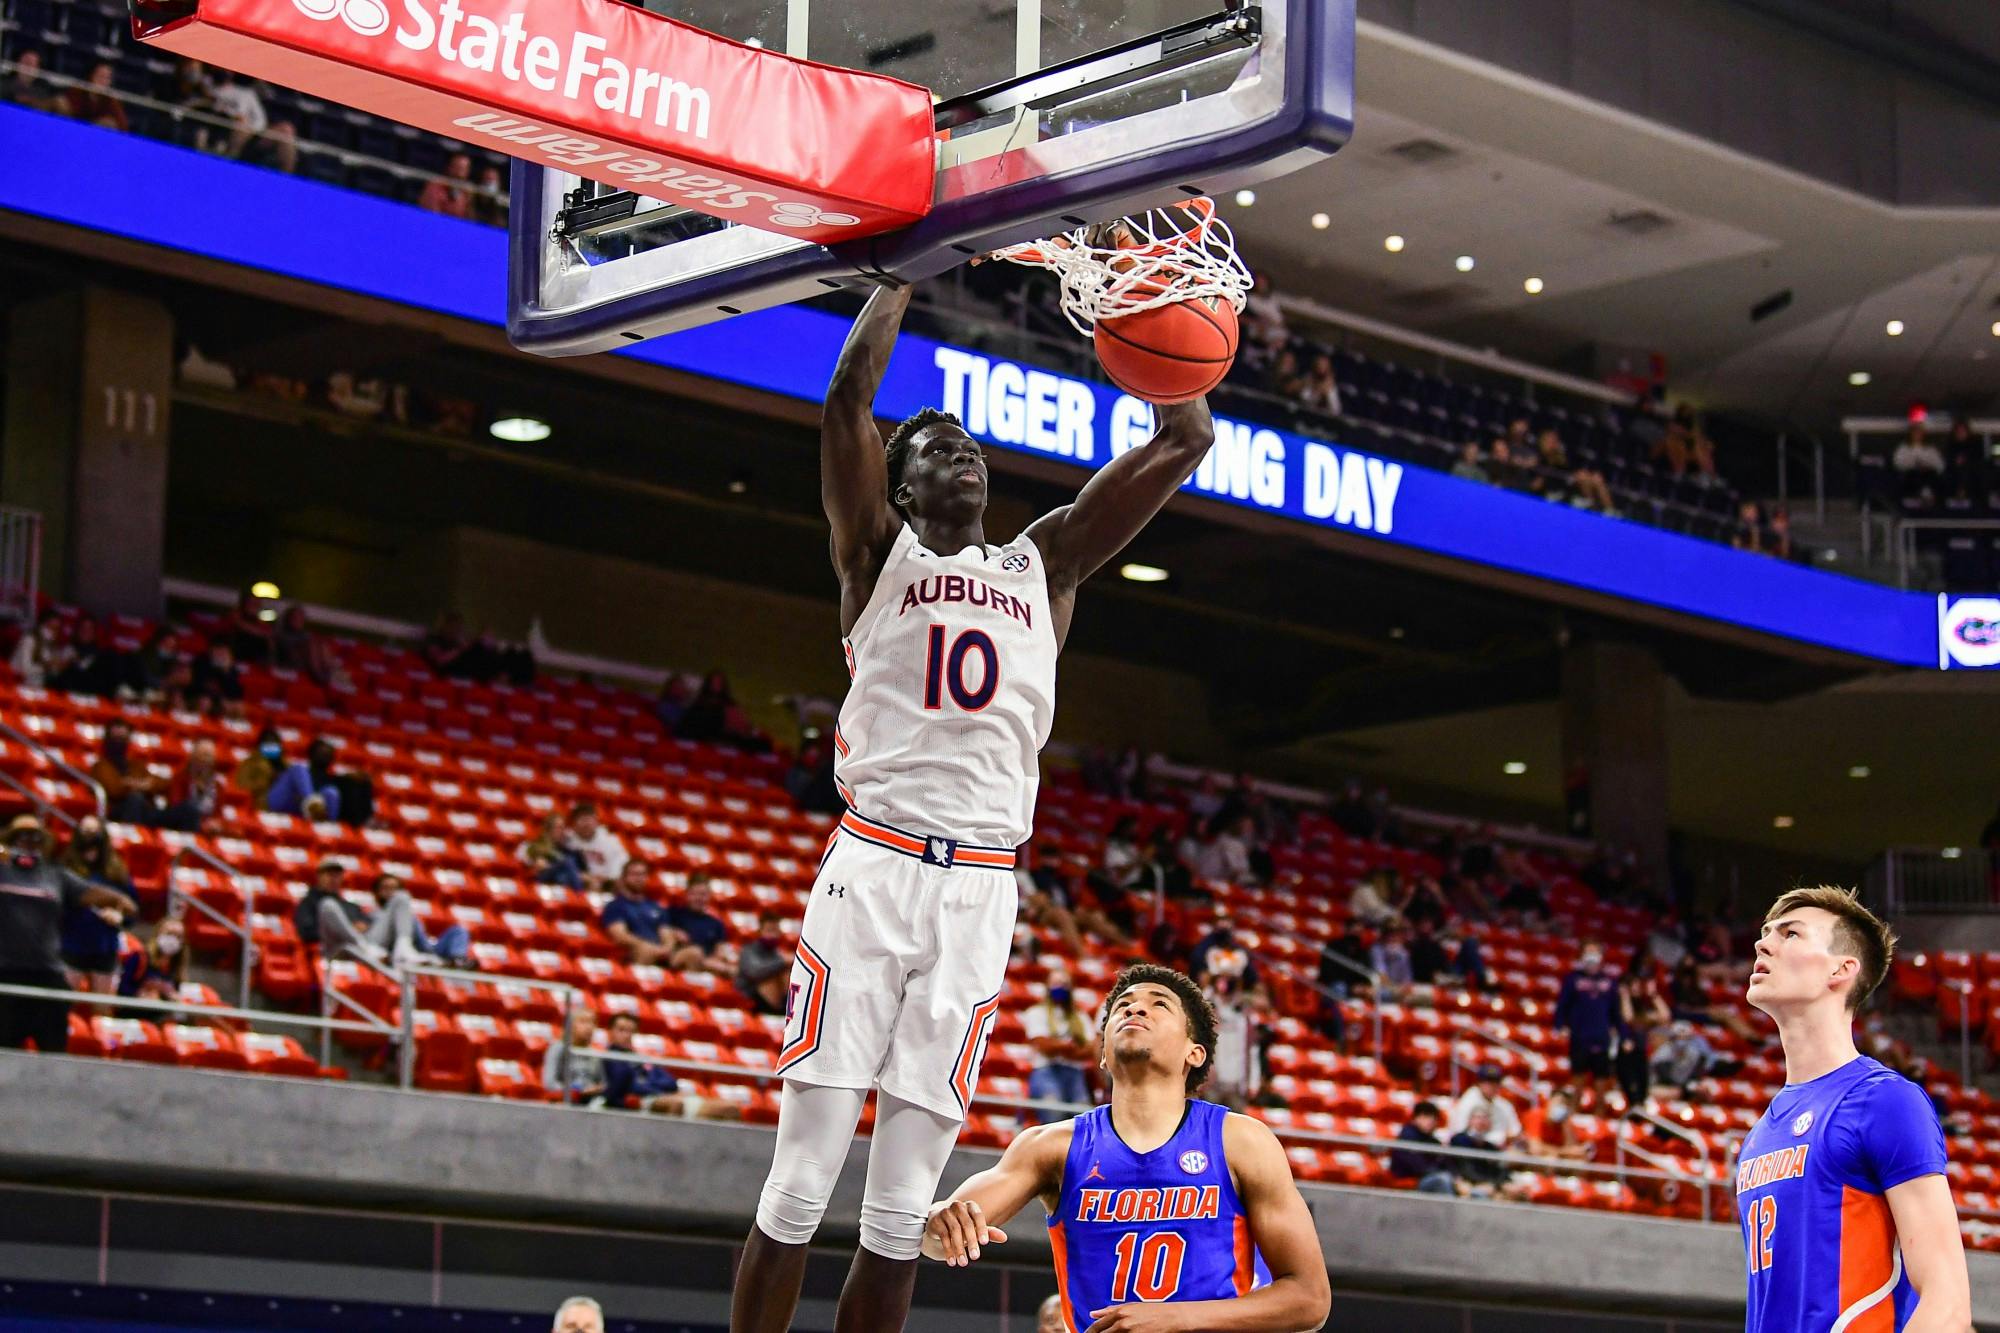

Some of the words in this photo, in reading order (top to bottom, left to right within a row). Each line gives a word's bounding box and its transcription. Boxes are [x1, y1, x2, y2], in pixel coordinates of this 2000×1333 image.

[104, 386, 157, 435] 111
[935, 346, 1095, 461] TIGER
[1110, 394, 1286, 509] GING
[1303, 441, 1403, 535] DAY
[899, 575, 1032, 631] AUBURN
[924, 623, 1000, 713] 10
[1181, 1151, 1207, 1173] SEC
[1736, 1144, 1809, 1195] FLORIDA
[1076, 1185, 1220, 1222] FLORIDA
[1748, 1194, 1777, 1275] 12
[1111, 1232, 1186, 1303] 10
